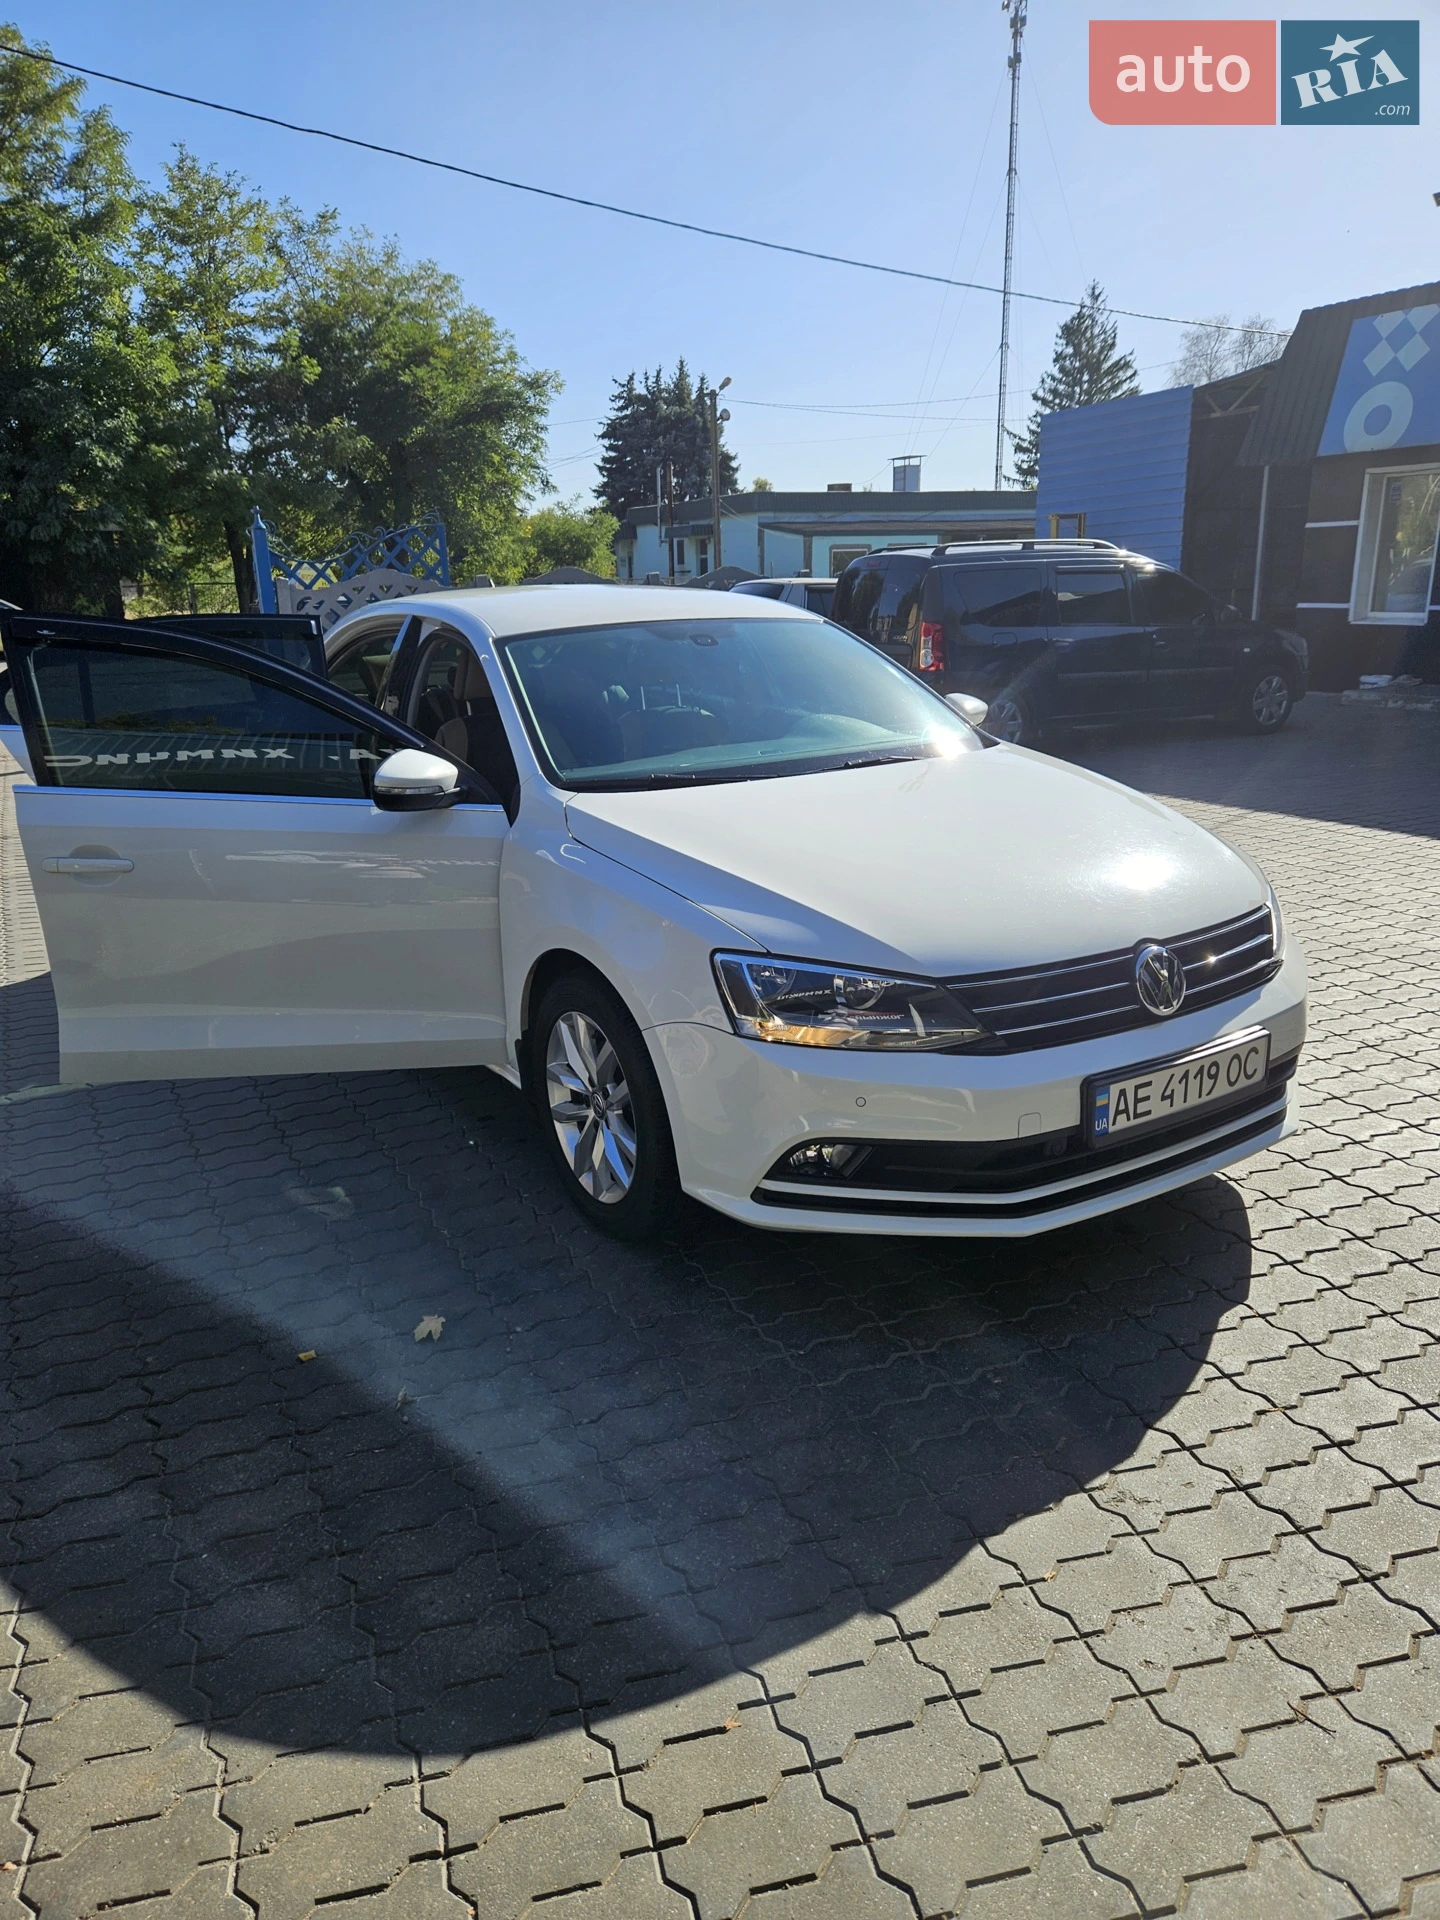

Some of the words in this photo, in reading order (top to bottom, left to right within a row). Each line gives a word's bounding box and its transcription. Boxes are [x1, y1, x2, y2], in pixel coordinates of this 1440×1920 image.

[1112, 1080, 1153, 1126] AE
[1160, 1060, 1220, 1107] 4119
[1226, 1046, 1259, 1088] OC
[1095, 1118, 1108, 1131] UA
